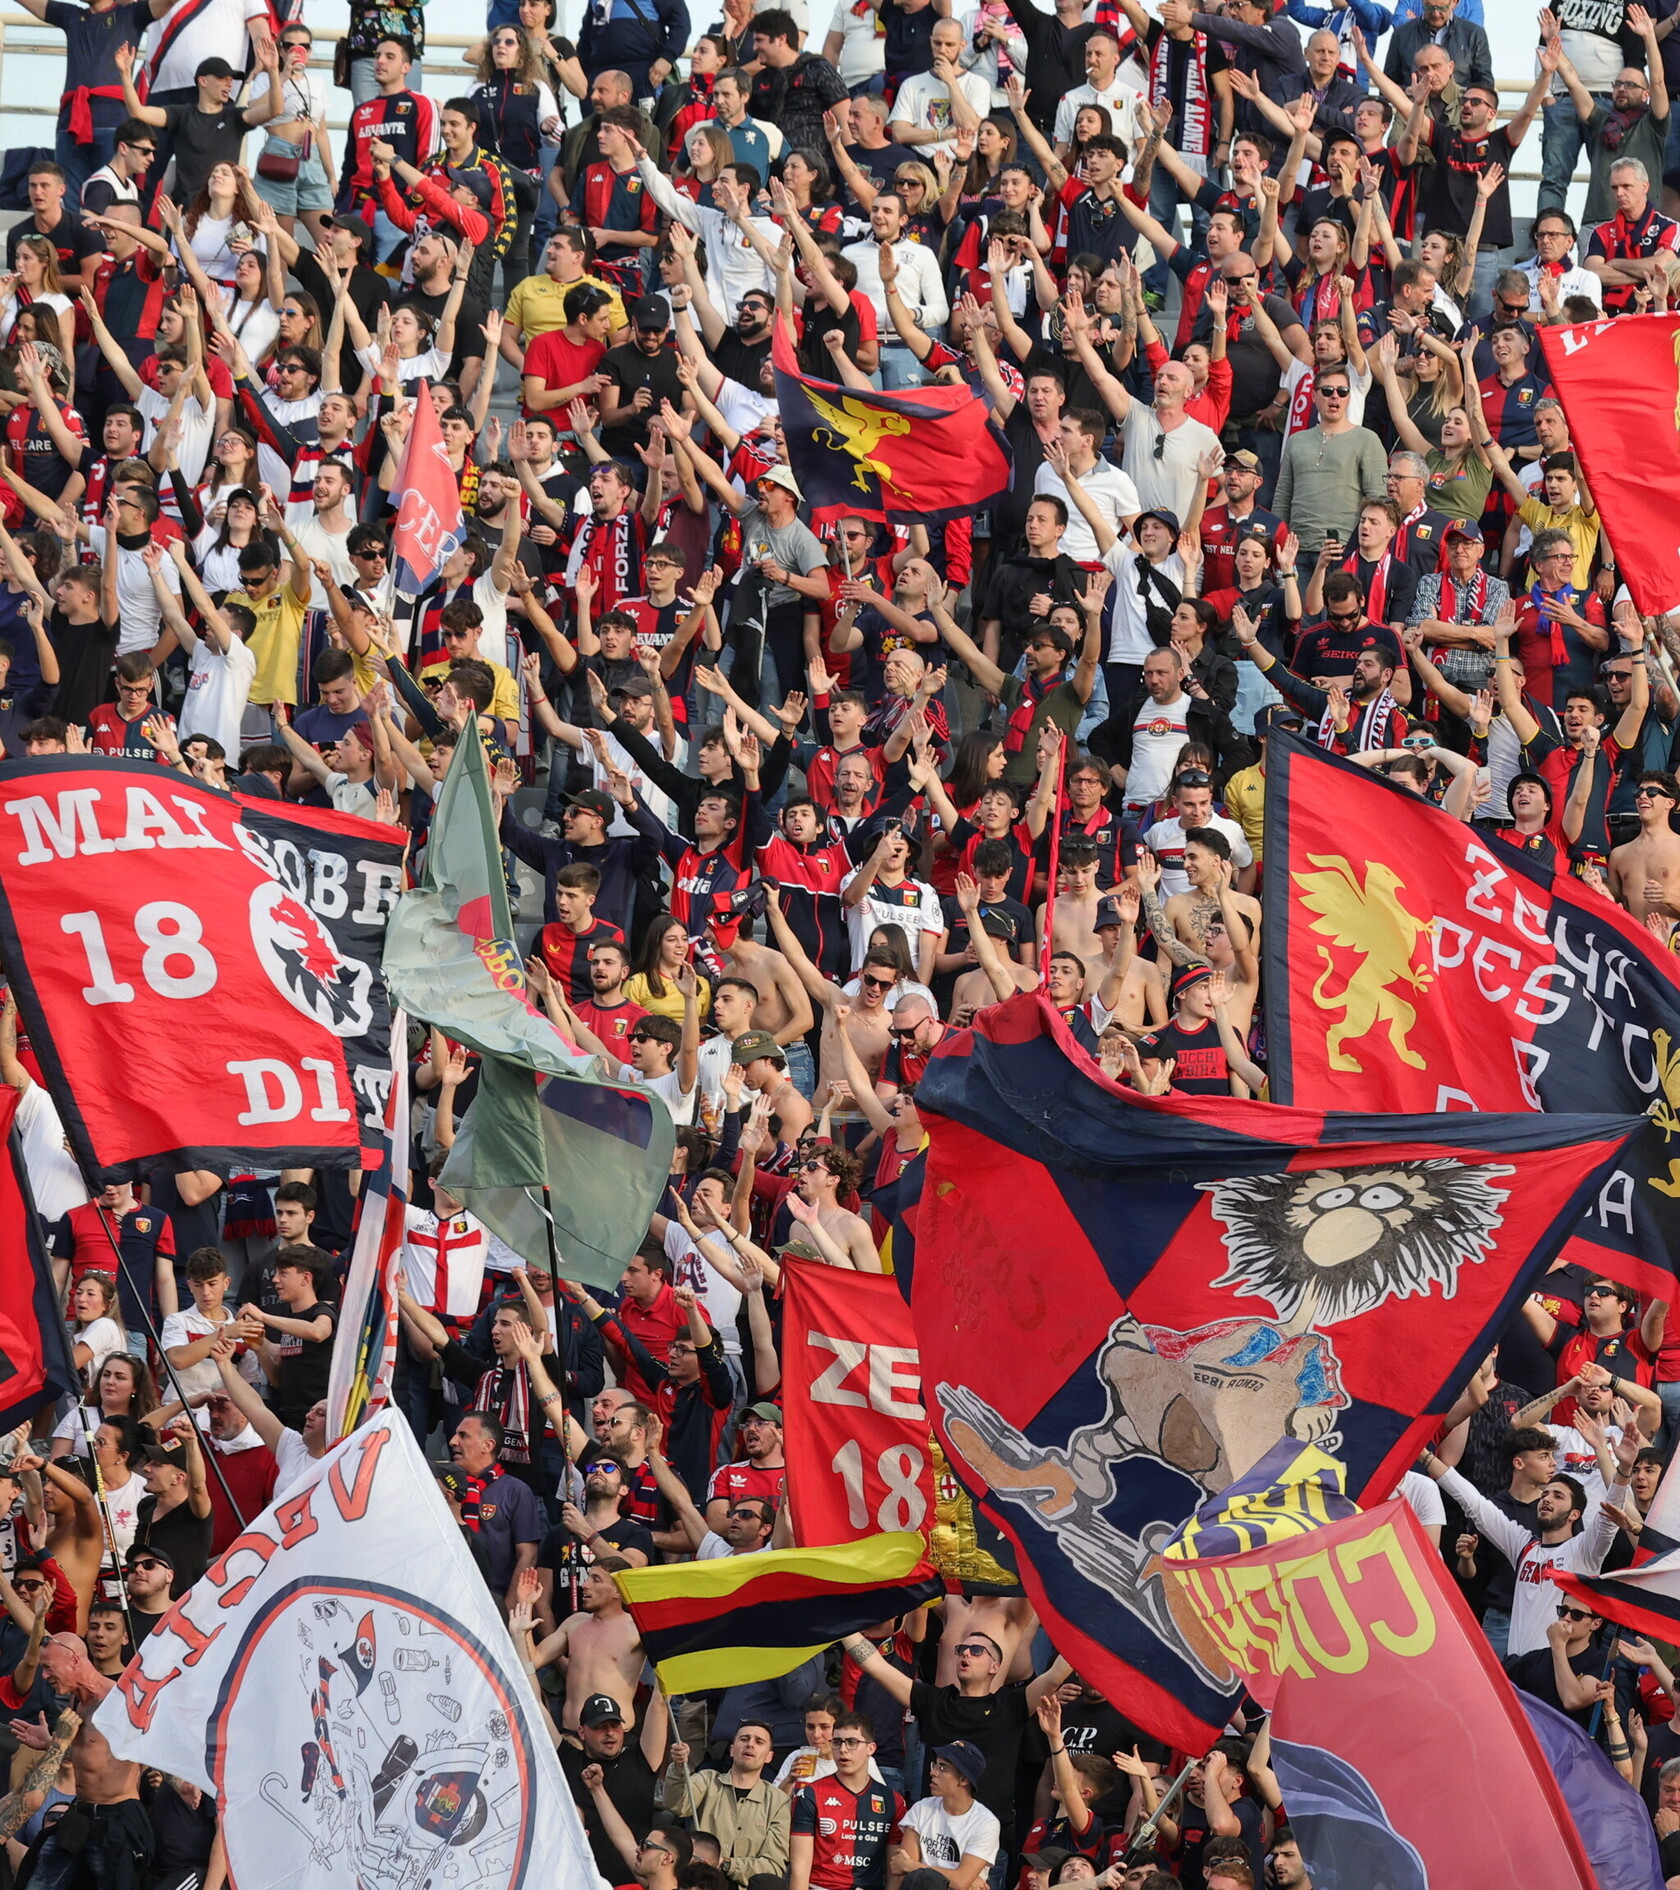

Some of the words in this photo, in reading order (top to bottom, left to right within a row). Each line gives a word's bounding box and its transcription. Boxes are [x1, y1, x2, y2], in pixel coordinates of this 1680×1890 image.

[1181, 103, 1204, 155] ALONE
[614, 514, 629, 592] FORZA
[636, 633, 675, 646] EVANT
[108, 746, 156, 760] PULSEE
[1061, 1726, 1098, 1749] C.P.
[842, 1819, 891, 1833] PULSEE
[841, 1833, 858, 1841] Luce
[865, 1833, 879, 1842] Gas
[921, 1836, 950, 1851] NORTH
[935, 1832, 950, 1844] THE
[844, 1854, 871, 1867] MSC
[926, 1847, 948, 1861] FACE
